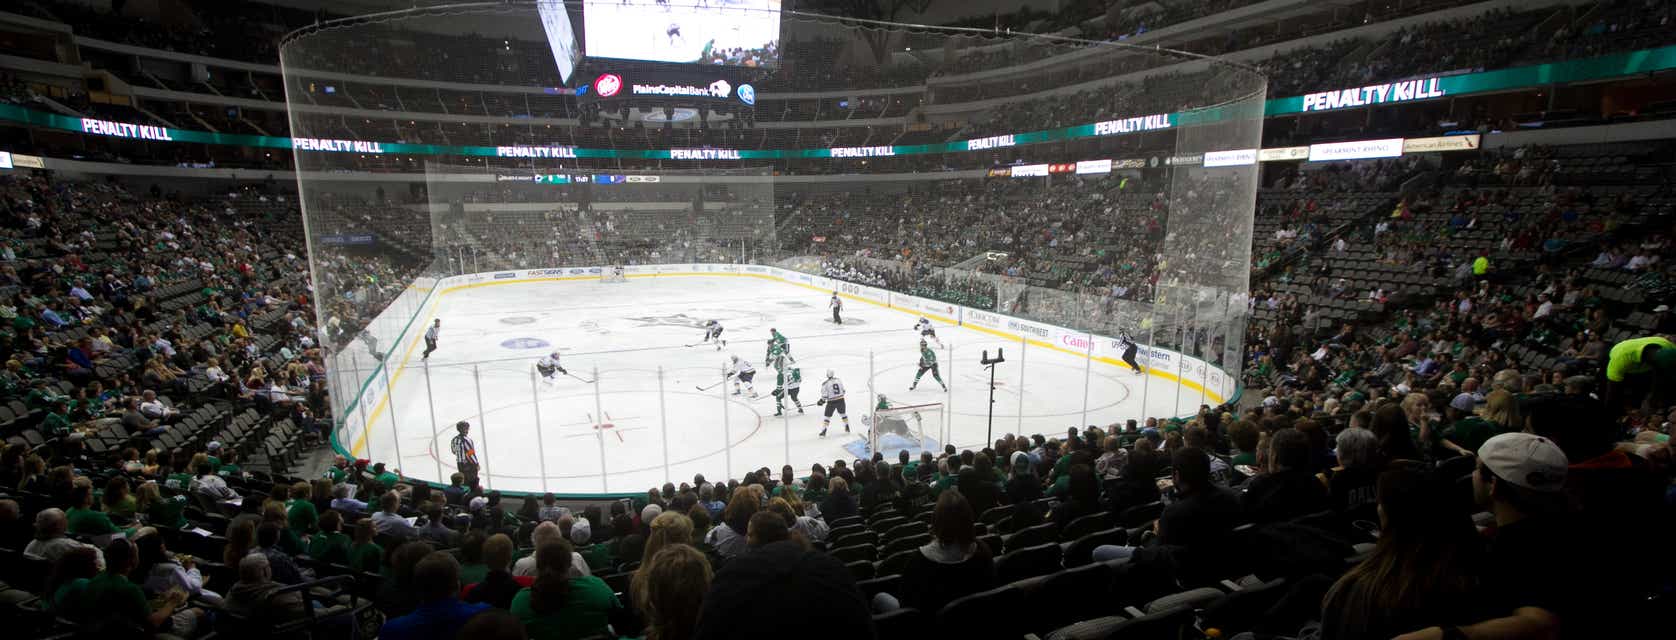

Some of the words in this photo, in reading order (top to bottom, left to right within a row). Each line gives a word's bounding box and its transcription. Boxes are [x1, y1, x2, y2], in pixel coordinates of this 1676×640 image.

[1302, 83, 1391, 112] PENALTY
[1392, 77, 1444, 102] KILL
[81, 118, 138, 138] PENALTY
[139, 125, 172, 141] KILL
[1094, 116, 1145, 136] PENALTY
[1144, 113, 1171, 131] KILL
[292, 138, 351, 152] PENALTY
[353, 140, 384, 154] KILL
[967, 136, 999, 151] PENALTY
[999, 134, 1016, 147] KILL
[496, 146, 550, 158] PENALTY
[551, 147, 577, 159] KILL
[670, 149, 716, 160] PENALTY
[718, 149, 742, 160] KILL
[830, 147, 875, 157] PENALTY
[876, 146, 896, 156] KILL
[1062, 334, 1096, 351] Canon
[832, 383, 841, 395] 9
